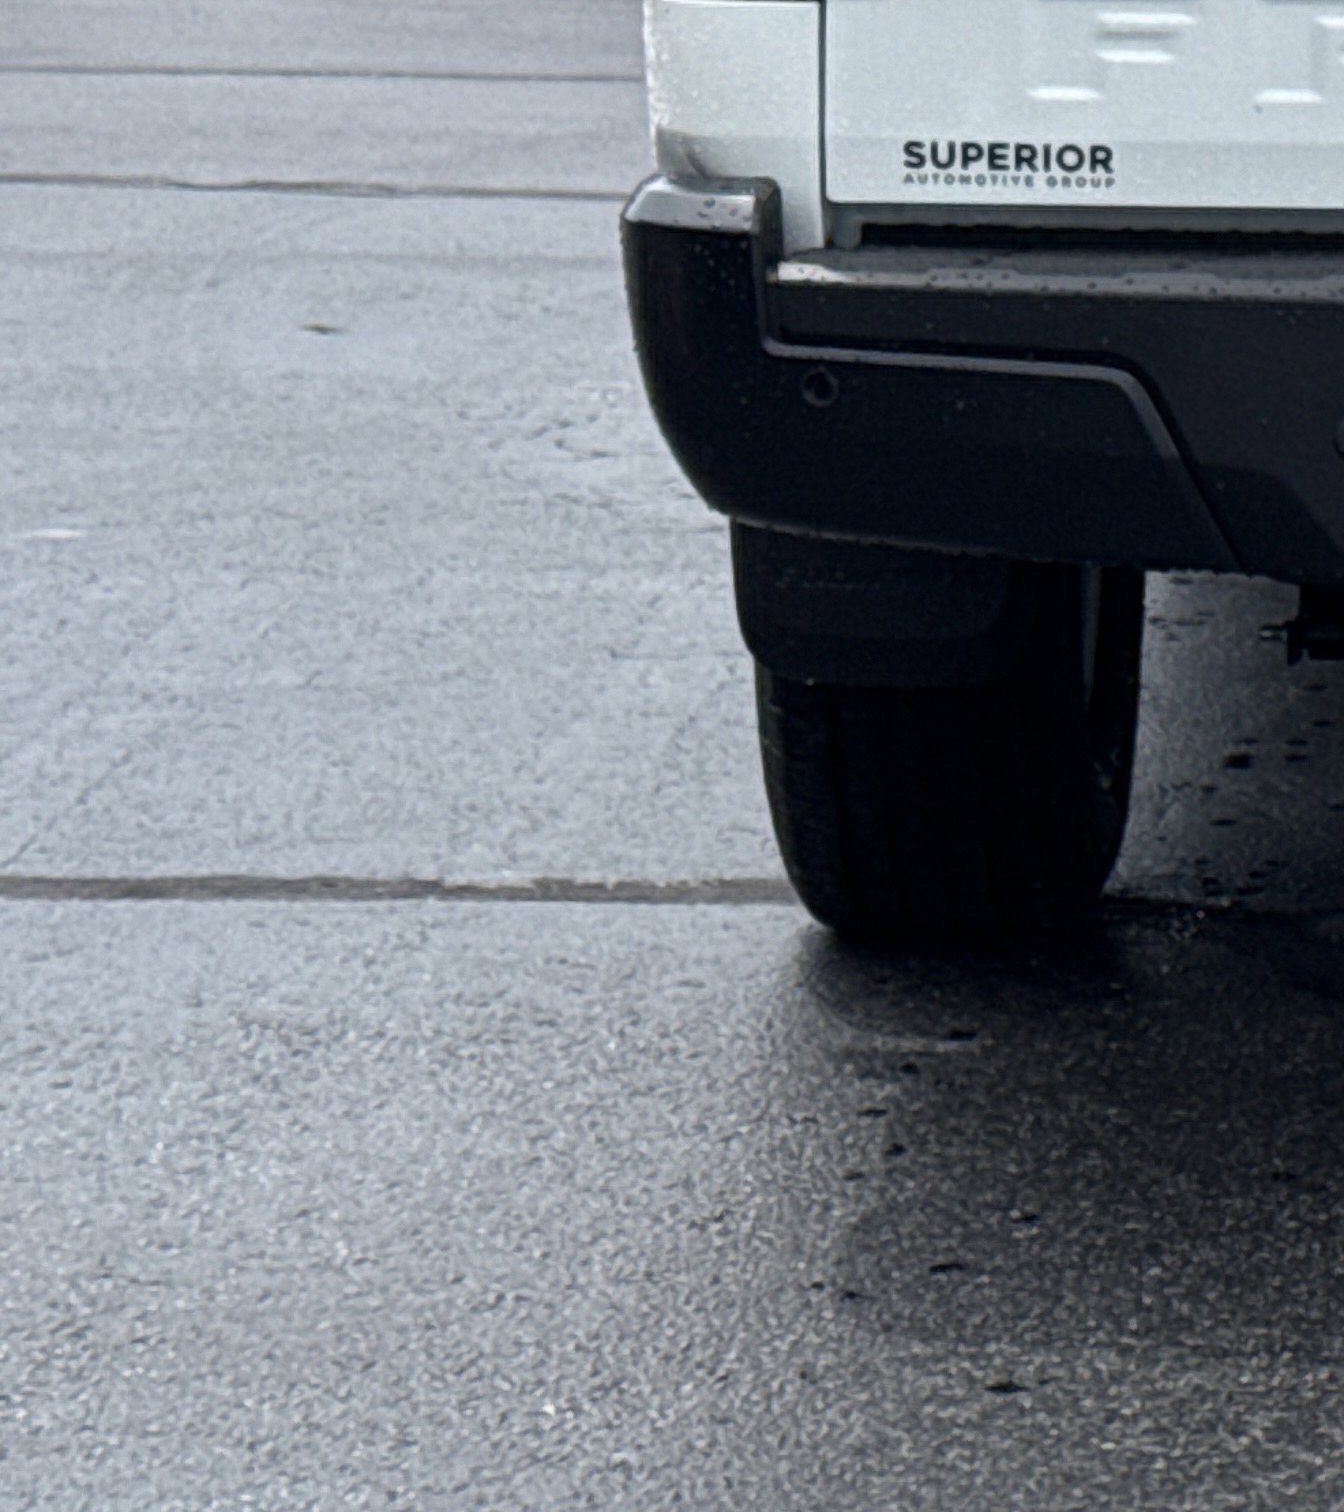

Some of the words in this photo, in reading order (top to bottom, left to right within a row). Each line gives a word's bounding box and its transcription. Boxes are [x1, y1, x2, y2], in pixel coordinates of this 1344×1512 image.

[903, 140, 1115, 175] SUPERIOR
[903, 173, 1035, 188] AUTOMOTIVE
[1046, 175, 1116, 189] GROUP
